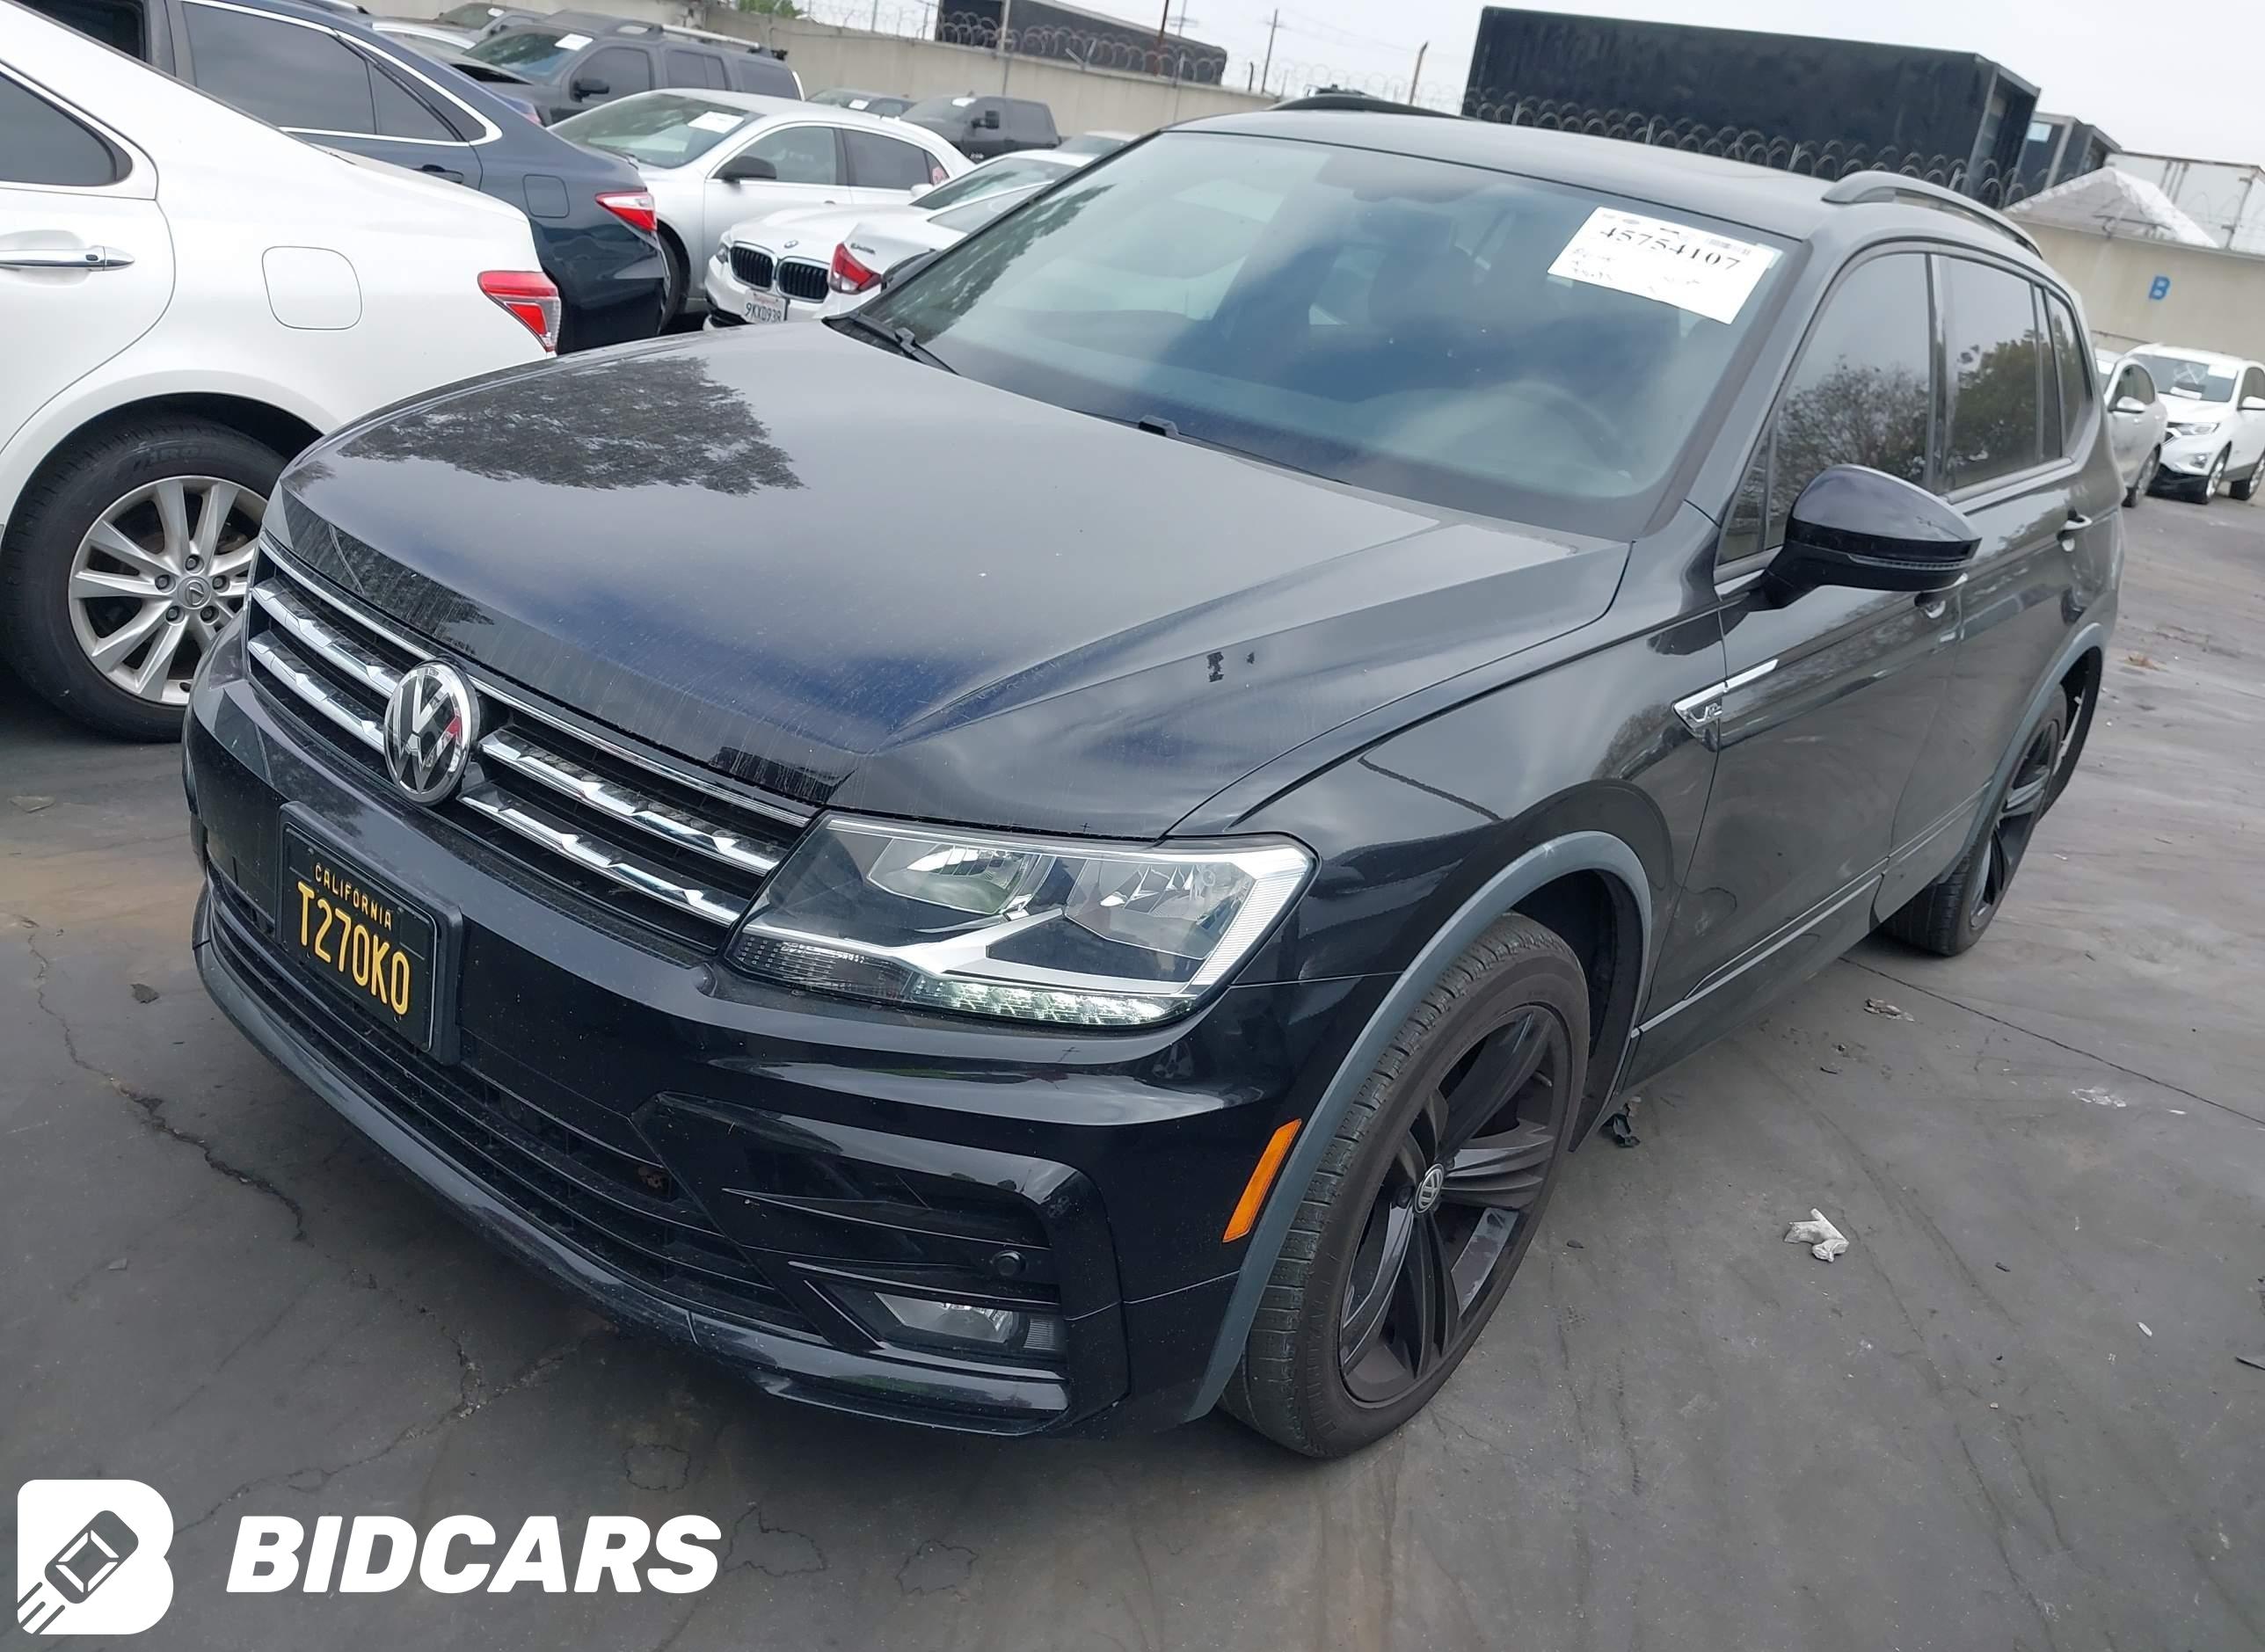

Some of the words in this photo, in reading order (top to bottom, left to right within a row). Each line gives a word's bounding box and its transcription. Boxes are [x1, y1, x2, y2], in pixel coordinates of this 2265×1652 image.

[1599, 226, 1740, 270] 45754107
[2148, 275, 2171, 300] B
[386, 663, 471, 802] VW
[315, 862, 393, 931] CALIFORNIA
